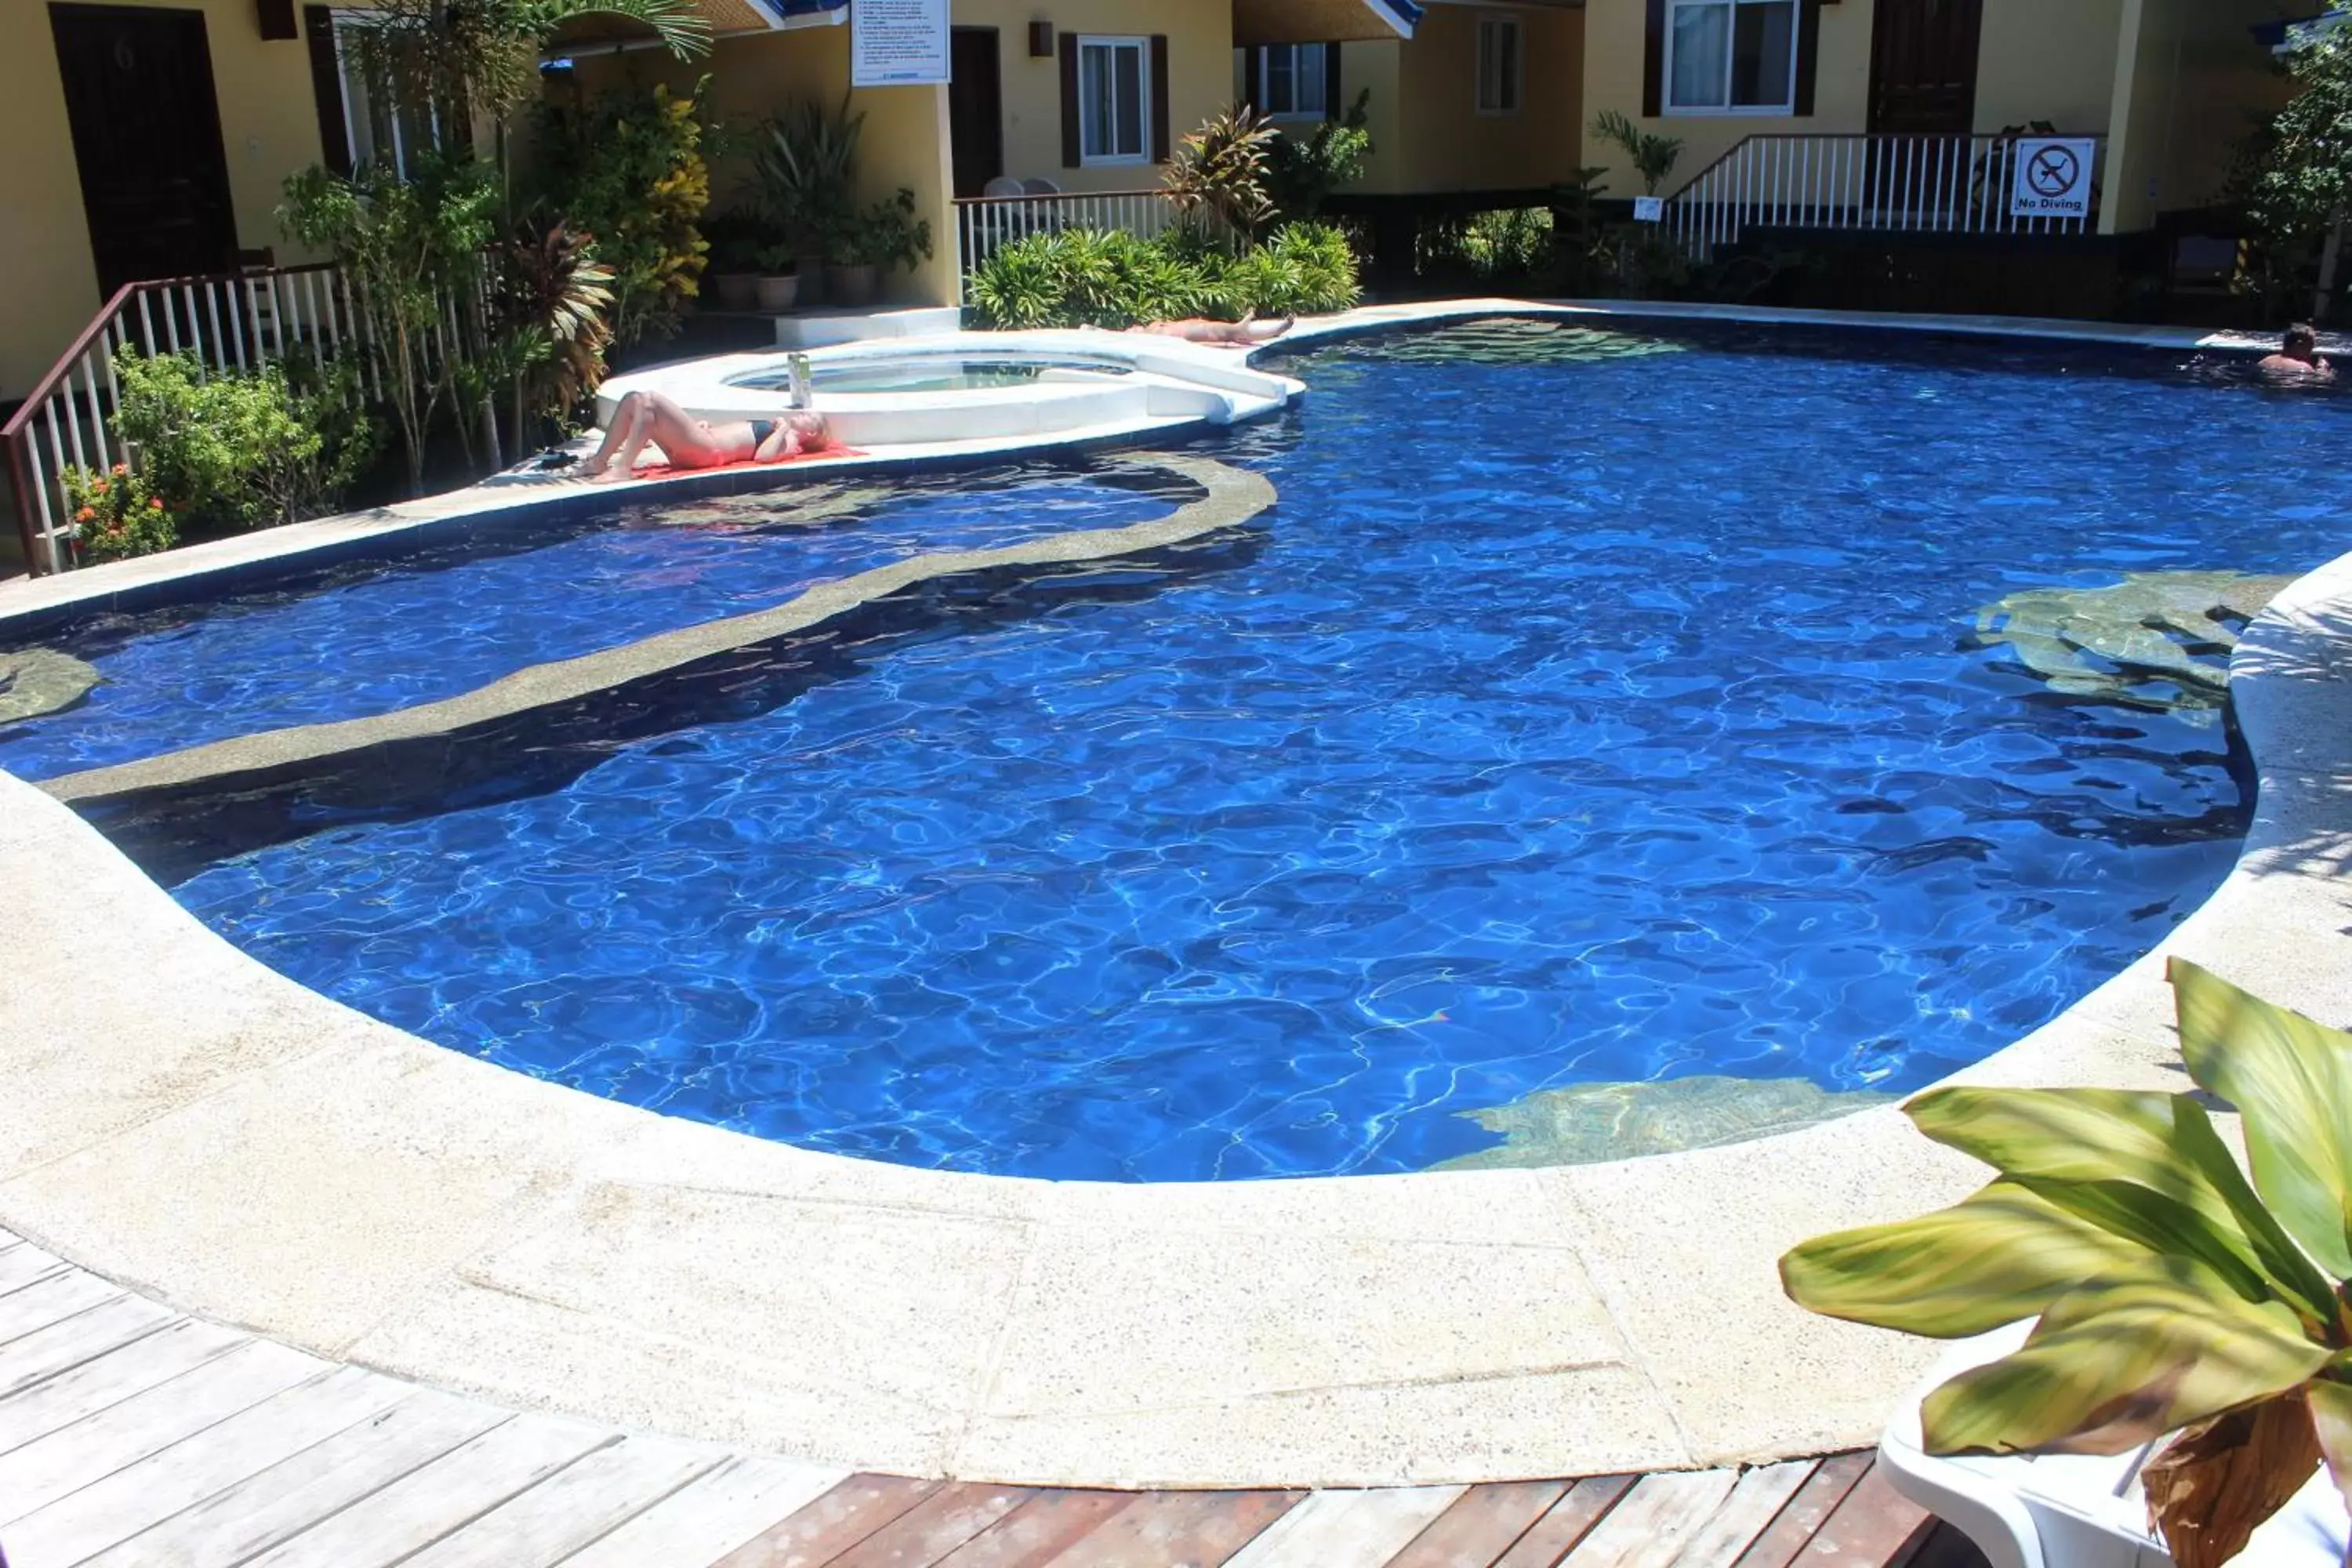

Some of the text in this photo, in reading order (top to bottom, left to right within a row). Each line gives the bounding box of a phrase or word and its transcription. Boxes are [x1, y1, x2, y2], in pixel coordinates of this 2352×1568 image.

[114, 35, 135, 71] 6
[2019, 198, 2082, 211] No Diving
